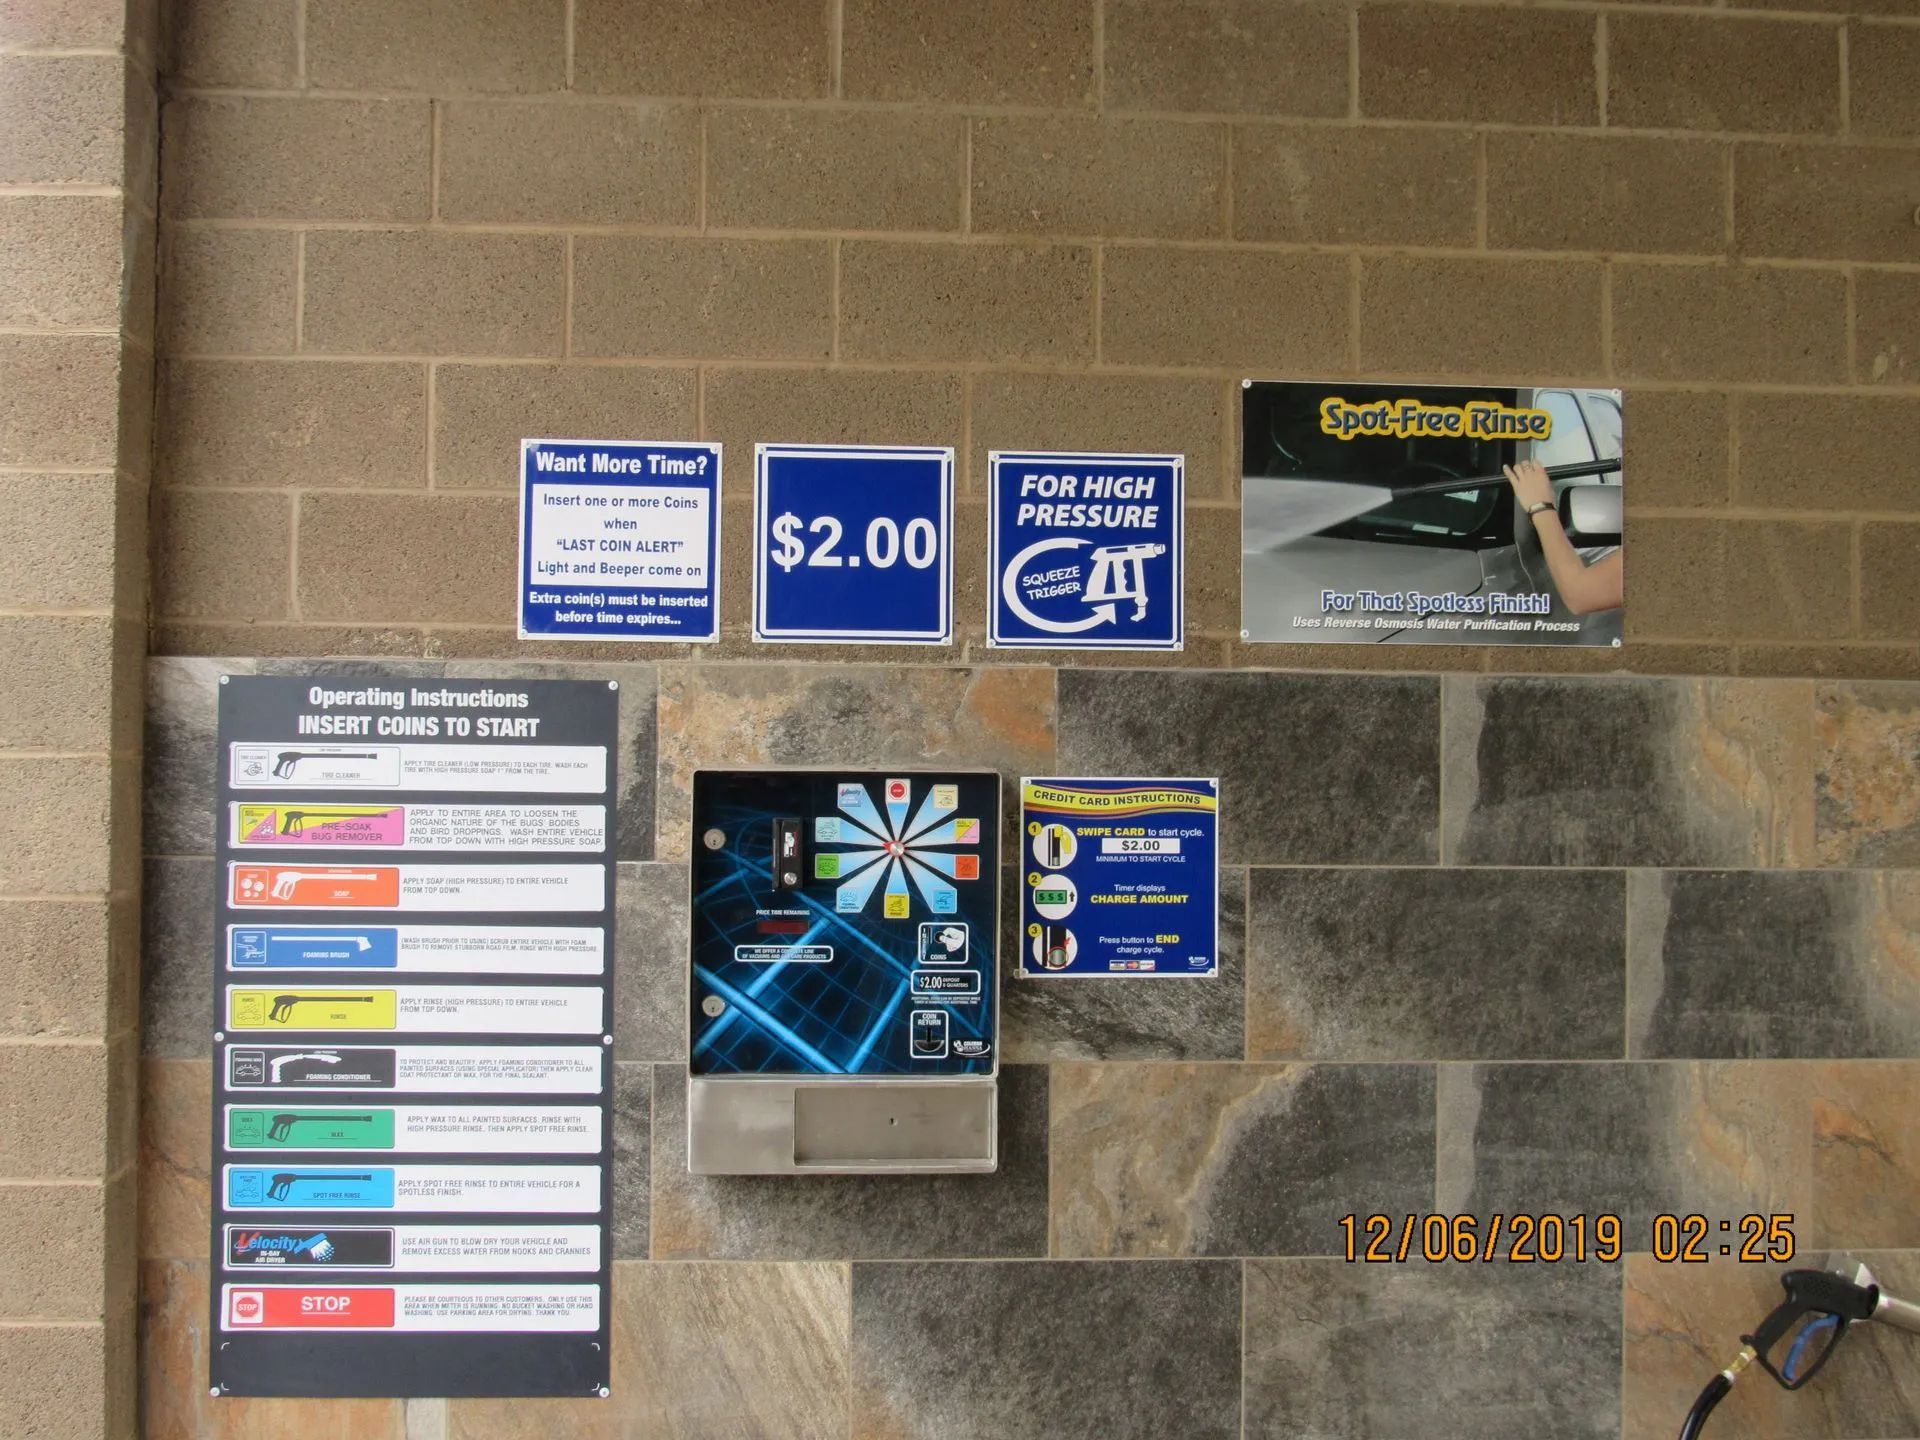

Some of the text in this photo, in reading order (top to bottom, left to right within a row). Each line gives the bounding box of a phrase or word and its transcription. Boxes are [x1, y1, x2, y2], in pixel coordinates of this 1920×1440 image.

[1325, 403, 1546, 434] Spot-Free Rinse
[536, 452, 707, 475] Want More Time?
[1020, 475, 1155, 499] FOR HIGH
[544, 494, 698, 508] Insert one or more Coins
[1017, 504, 1159, 528] PRESSURE
[604, 518, 637, 529] when
[600, 540, 631, 552] COIN
[771, 512, 937, 572] $2.00
[538, 562, 701, 576] Light and Beeper come on
[1022, 565, 1081, 587] SQUEEZE
[1026, 582, 1081, 600] TRIGGER
[530, 592, 707, 607] Extra coin(s) must be inserted
[1321, 591, 1550, 615] For That Spotless Finish!
[555, 611, 681, 626] before time expires...
[1292, 616, 1580, 632] Uses Reverse Osmosis Water Purification Process
[309, 687, 529, 710] Operating Instructions
[298, 715, 540, 738] INSERT COINS TO START
[1034, 790, 1201, 806] CREDIT CARD INSTRUCTIONS
[410, 809, 434, 817] APPLY
[438, 809, 448, 817] TO
[524, 810, 558, 818] LOOSEN
[562, 810, 577, 818] THE
[321, 823, 372, 831] PRE-SOAK
[410, 818, 448, 826] ORGANIC
[502, 819, 517, 827] THE
[549, 819, 580, 827] BODIES
[1032, 823, 1037, 832] 1
[311, 832, 382, 841] BUG REMOVER
[453, 828, 503, 836] DROPPINGS.
[1077, 828, 1111, 836] SWIPE
[1115, 828, 1146, 836] CARD
[1180, 828, 1205, 838] cycle.
[409, 837, 433, 845] FROM
[437, 837, 452, 845] TOP
[456, 837, 481, 845] DOWN
[531, 838, 575, 846] PRESSURE
[1122, 840, 1160, 851] $2.00
[1031, 875, 1038, 883] 2
[1114, 884, 1166, 893] Timer displays
[1091, 895, 1189, 903] CHARGE AMOUNT
[1031, 926, 1038, 934] 3
[1156, 934, 1180, 944] END
[1117, 946, 1164, 954] charge cycle.
[920, 976, 942, 989] $2.00
[402, 1247, 432, 1255] REMOVE
[238, 1303, 257, 1311] STOP
[301, 1297, 350, 1310] STOP
